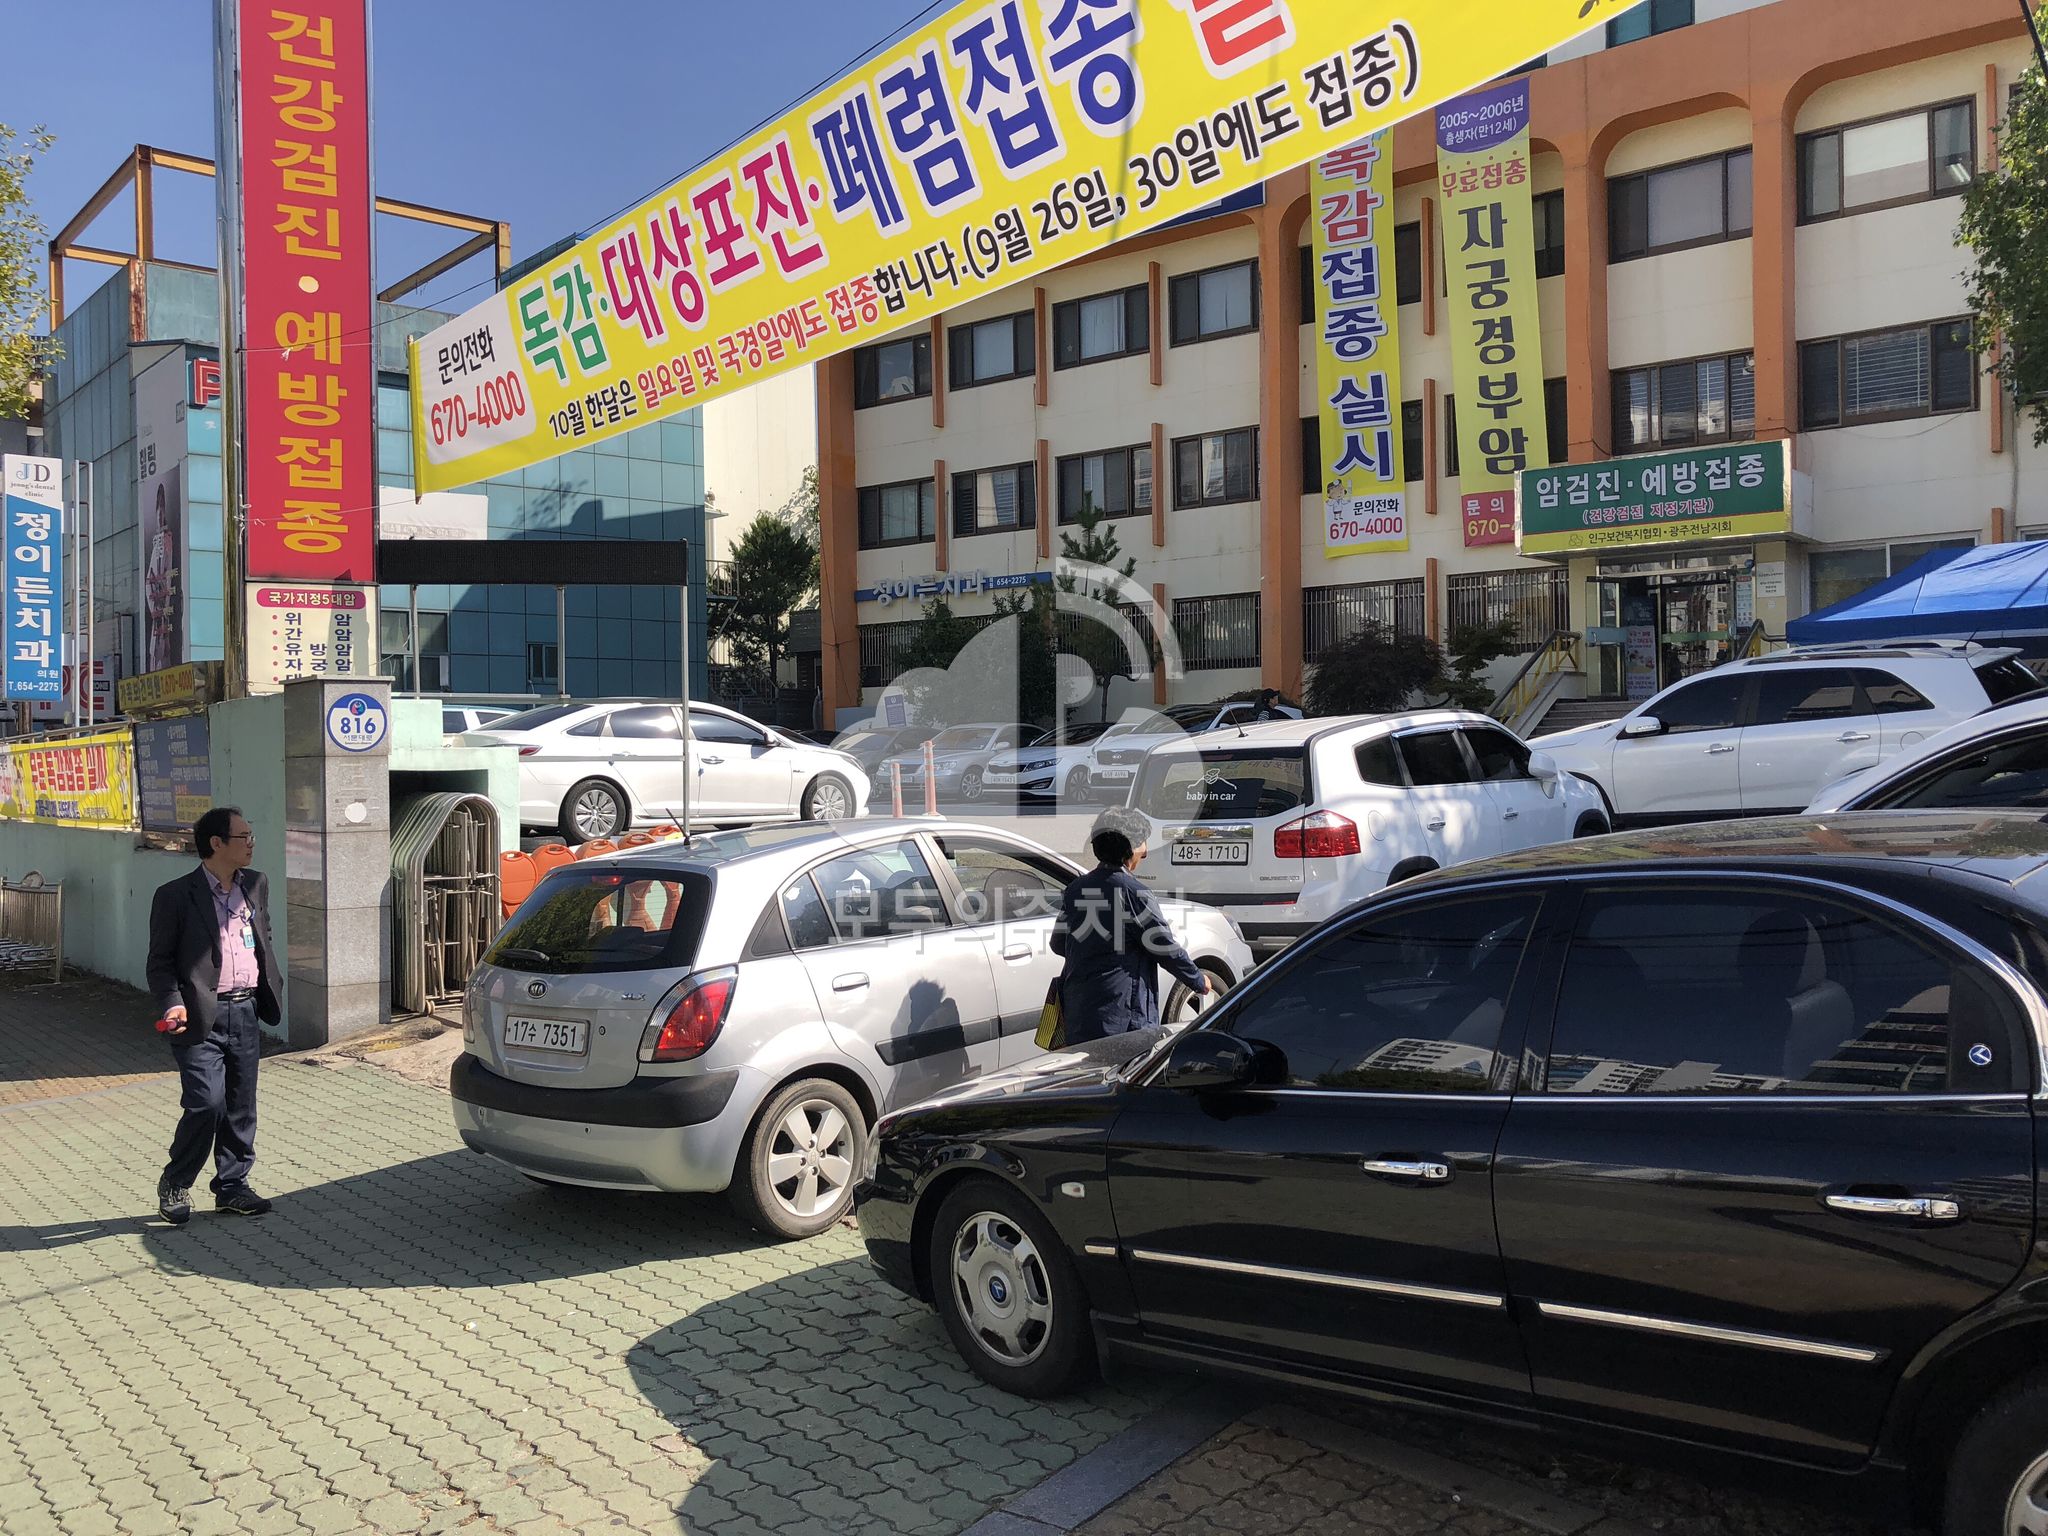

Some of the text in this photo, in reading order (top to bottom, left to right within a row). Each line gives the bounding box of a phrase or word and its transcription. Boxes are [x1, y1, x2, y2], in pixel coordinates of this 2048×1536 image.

[1439, 94, 1524, 130] 2005~2006년
[1445, 116, 1518, 146] 출생자(만12세)
[1442, 156, 1528, 198] 무료접종
[549, 399, 586, 438] 10월
[585, 381, 638, 427] 한달은
[637, 355, 695, 409] 일요일
[694, 344, 720, 384] 및
[719, 301, 828, 371] 국경일에도
[1031, 169, 1128, 241] 26일,
[1128, 83, 1299, 208] 30일에도
[1303, 24, 1419, 128] 접종)
[1457, 201, 1529, 475] 자궁경부암
[437, 325, 496, 386] 문의전화
[430, 370, 527, 445] 670-4000
[1329, 373, 1391, 477] 실시
[16, 462, 51, 482] JD
[25, 490, 44, 498] clinic
[34, 483, 56, 491] dental
[1353, 498, 1400, 516] 문의전화
[1582, 497, 1715, 525] (건강검진 지정기관)
[1329, 516, 1403, 540] 670-4000
[13, 512, 55, 668] 정이든치과
[269, 591, 356, 606] 국가지정5대암
[872, 568, 987, 608] 정이든치과
[996, 575, 1027, 586] 654-2275
[8, 681, 59, 693] T.654-2275
[37, 669, 59, 679] 의원
[340, 716, 376, 735] 816
[1186, 791, 1237, 803] baby in car
[1178, 845, 1240, 860] 48수 1710
[530, 984, 545, 996] KIA
[513, 1020, 577, 1048] 17수 7351
